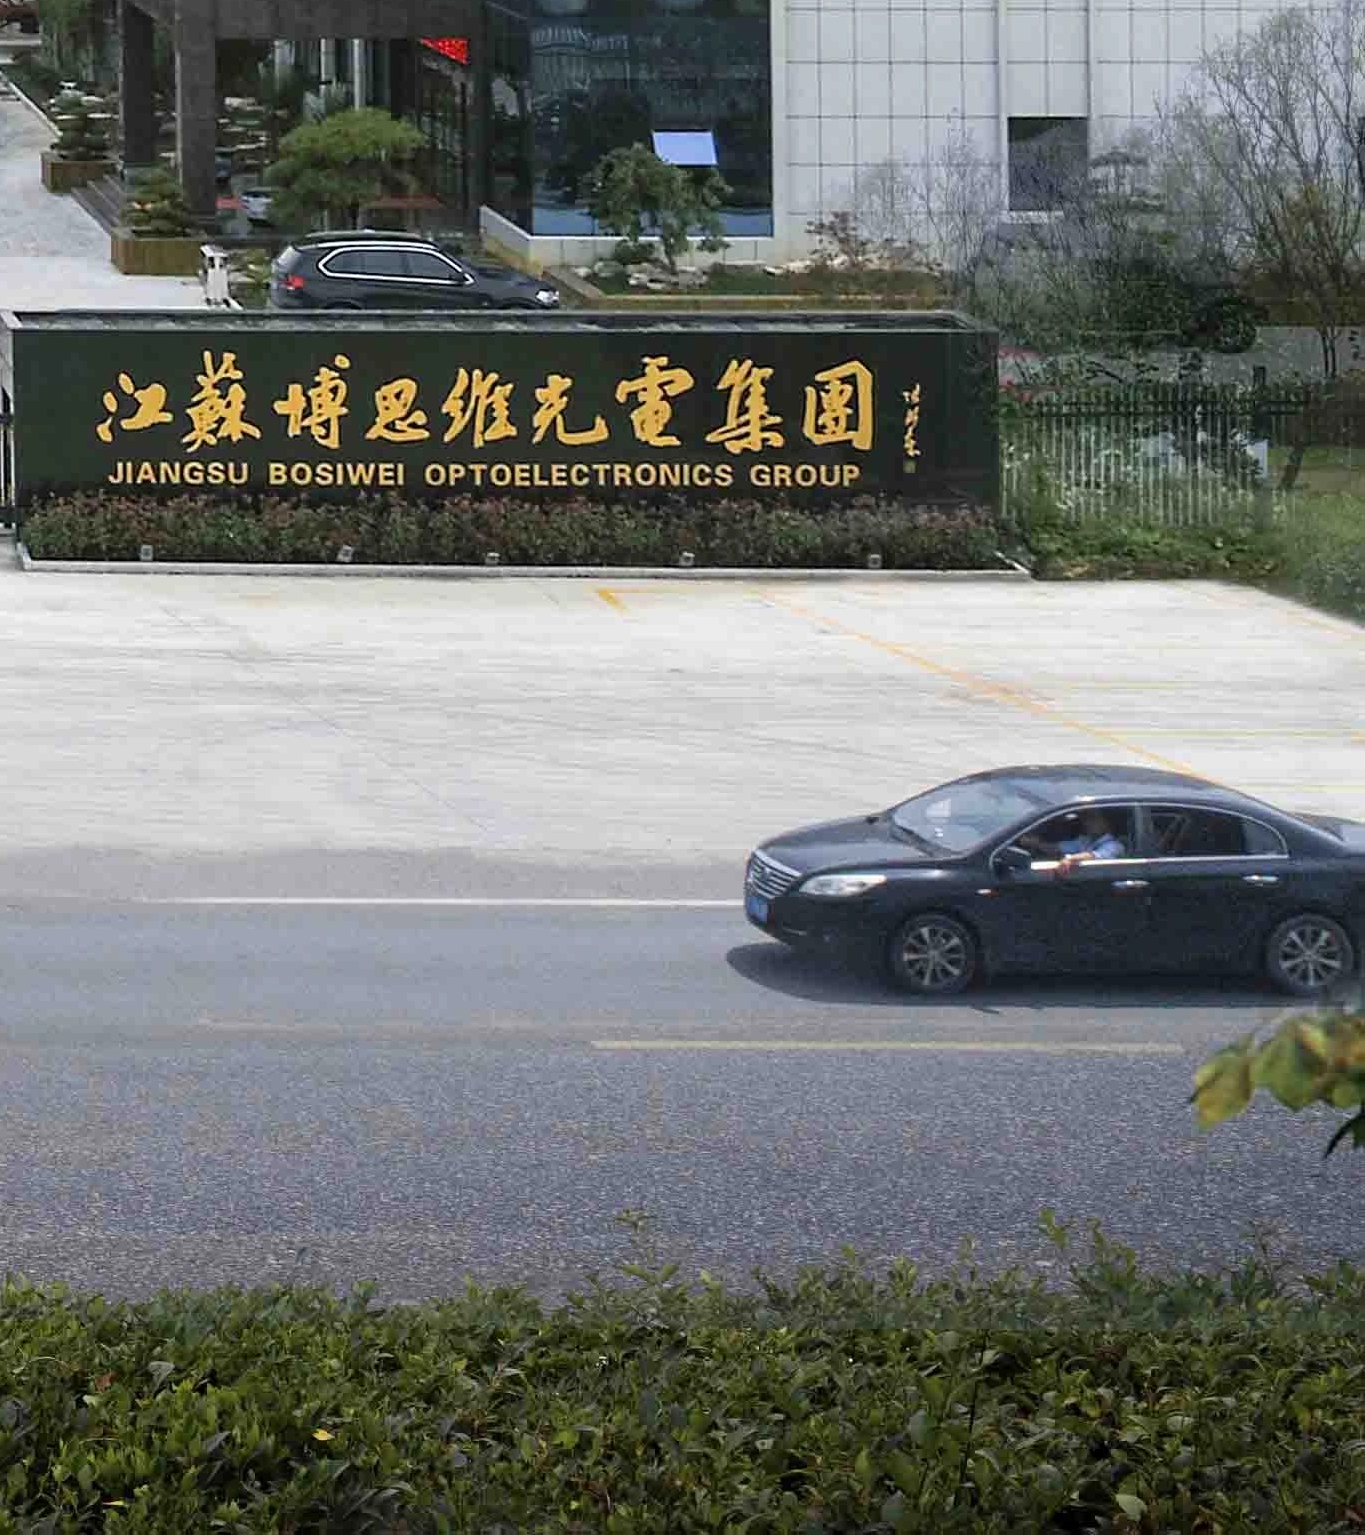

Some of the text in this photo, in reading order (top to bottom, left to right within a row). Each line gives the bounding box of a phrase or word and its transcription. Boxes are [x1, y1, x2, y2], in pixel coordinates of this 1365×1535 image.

[108, 462, 861, 488] JIANGSU BOSIWEI OPTOELECTRONICS GROUP
